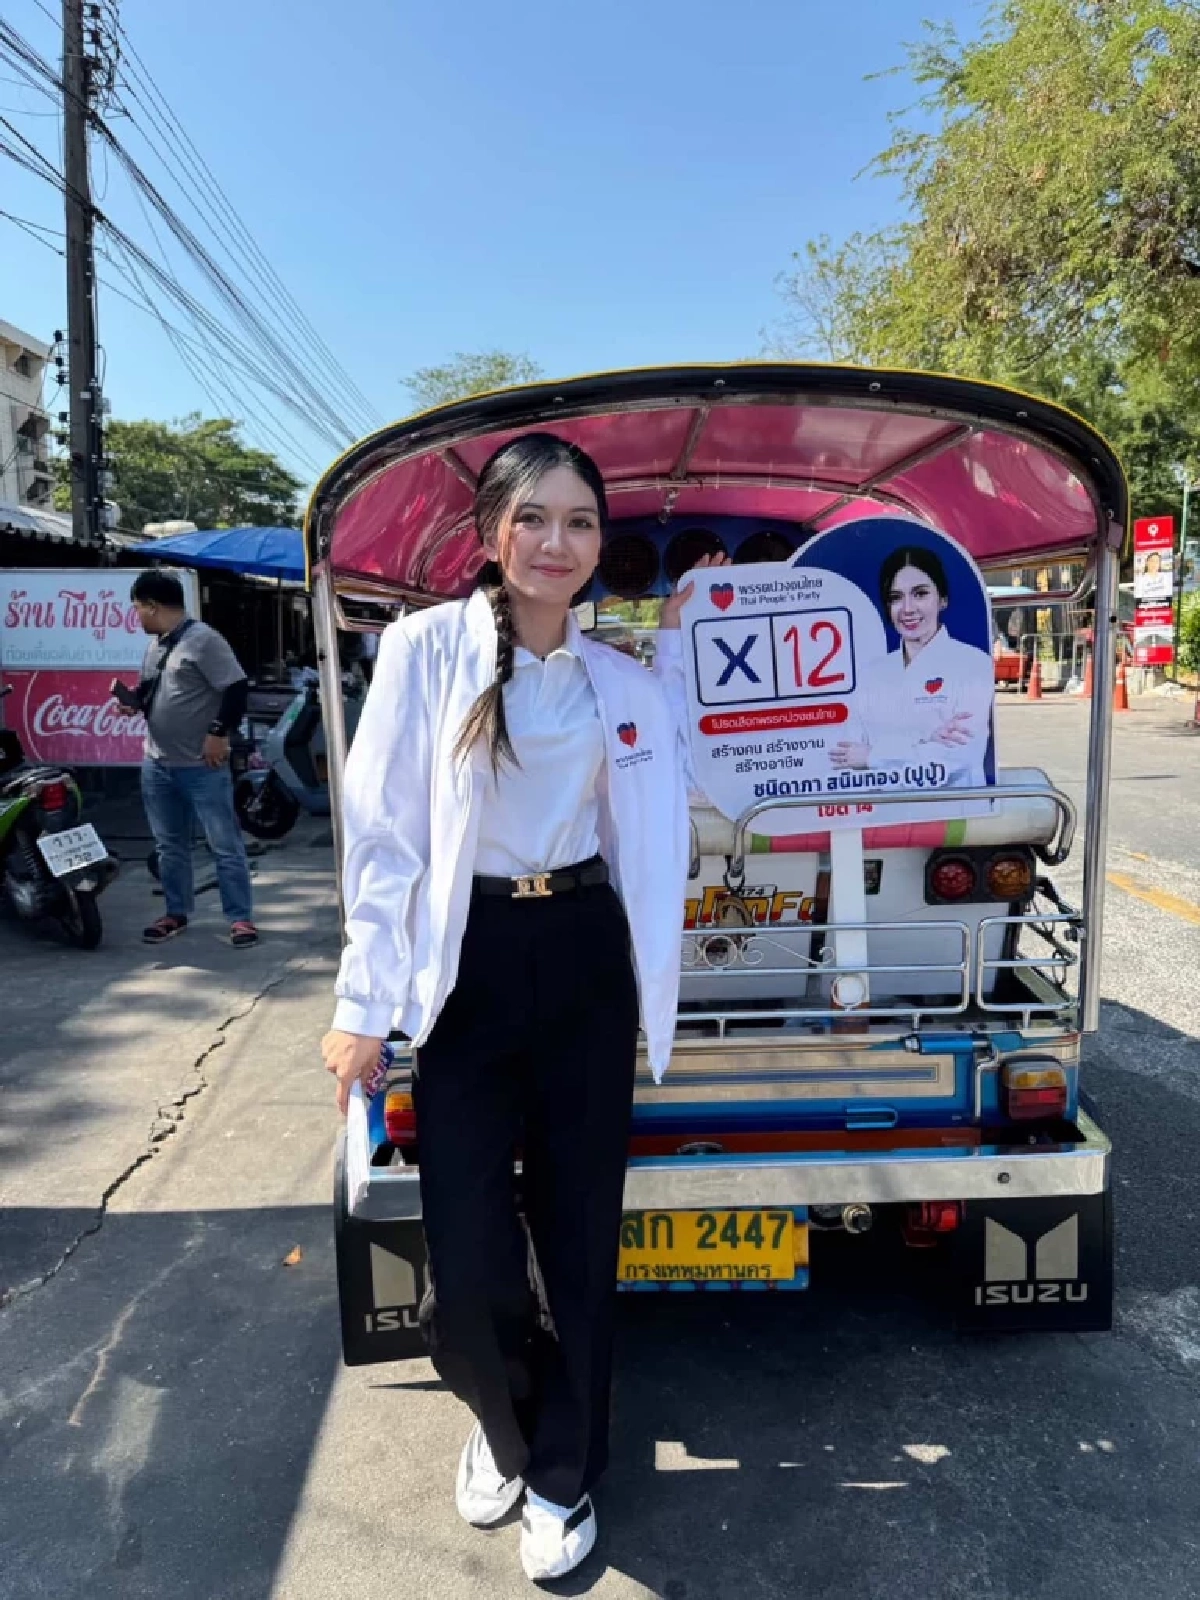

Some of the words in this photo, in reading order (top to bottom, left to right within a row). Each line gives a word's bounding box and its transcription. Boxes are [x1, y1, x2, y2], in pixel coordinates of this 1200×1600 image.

[740, 596, 757, 606] Thai
[759, 592, 795, 605] People's
[797, 590, 820, 602] Party
[5, 590, 56, 629] ร้าน
[711, 634, 762, 687] X
[783, 621, 845, 688] 12
[711, 744, 763, 759] สร้างคน
[766, 738, 826, 754] สร้างงาน
[735, 756, 804, 773] สร้างอาชีพ
[753, 778, 822, 798] ชนิดาภา
[621, 1211, 674, 1249] สก
[695, 1212, 788, 1250] 2447
[625, 1263, 773, 1279] กรงเทพมหานคร
[974, 1283, 1088, 1306] ISUZU
[364, 1308, 420, 1334] ISU
